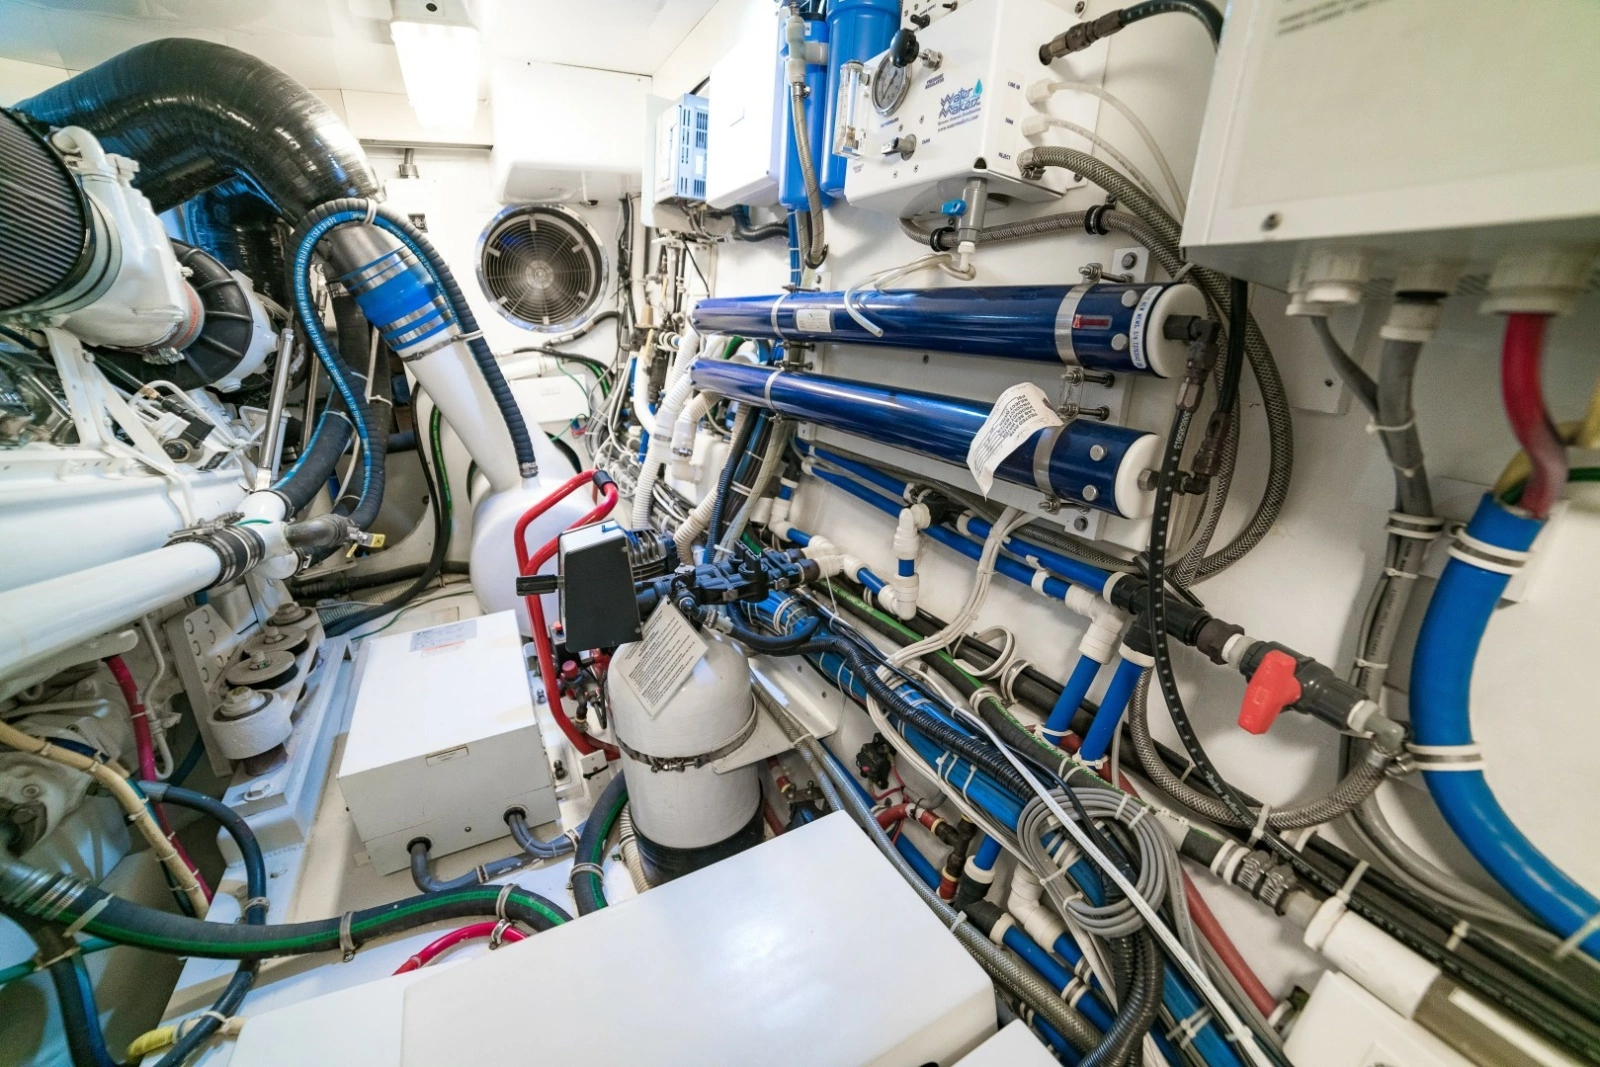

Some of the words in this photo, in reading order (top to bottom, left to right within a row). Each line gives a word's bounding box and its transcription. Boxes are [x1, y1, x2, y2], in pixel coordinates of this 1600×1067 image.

[940, 87, 973, 108] Water
[998, 152, 1011, 160] REJECT
[298, 236, 314, 263] CERTIFIED
[296, 263, 305, 299] CORRUGATED
[298, 299, 309, 322] MARINE
[305, 320, 315, 334] WET
[310, 332, 327, 358] EXHAUST
[1009, 401, 1030, 417] PRODUCT
[1012, 404, 1033, 421] PRODUCT
[1018, 412, 1038, 425] TESTED
[1205, 771, 1224, 794] Parker
